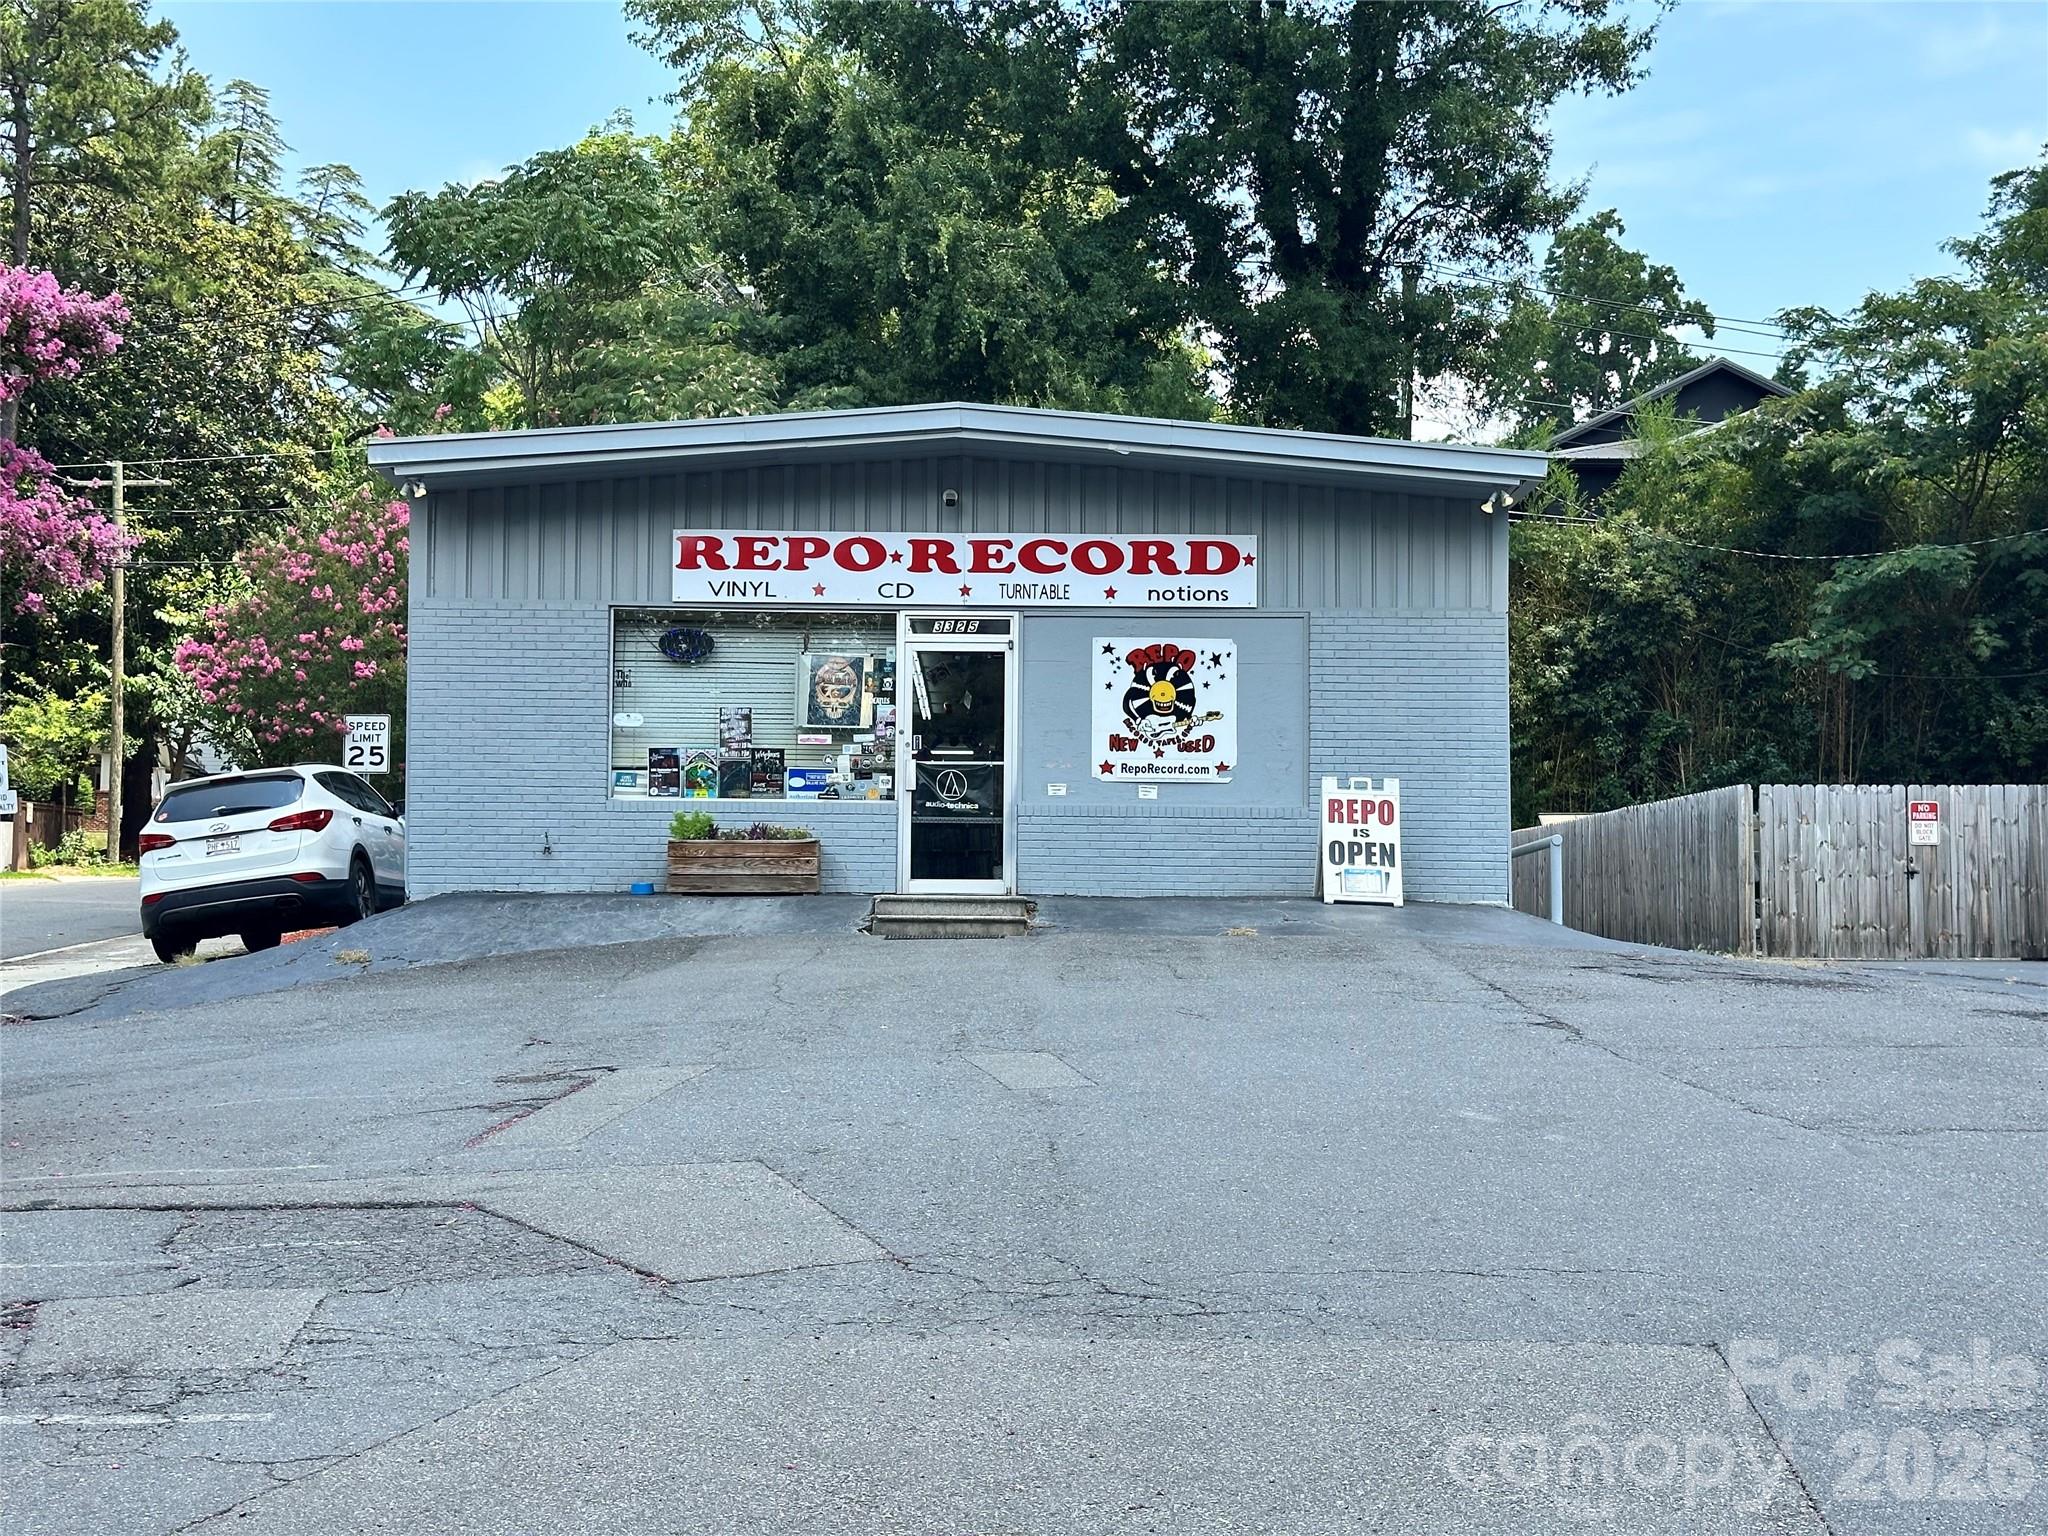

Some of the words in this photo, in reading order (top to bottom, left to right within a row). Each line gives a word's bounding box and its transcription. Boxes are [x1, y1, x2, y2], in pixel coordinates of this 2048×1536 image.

[675, 535, 887, 572] REPO
[907, 538, 1241, 576] RECORD
[708, 581, 777, 597] VINYL
[878, 583, 914, 598] CD
[999, 583, 1070, 600] TURNTABLE
[1147, 585, 1229, 602] notions
[933, 621, 979, 633] 3325
[1125, 643, 1197, 673] REPO
[348, 721, 386, 731] SPEED
[352, 733, 382, 743] LIMIT
[1109, 734, 1139, 752] NEW
[1177, 735, 1216, 752] USED
[348, 745, 385, 766] 25
[1120, 763, 1210, 776] RepoRecord.com
[925, 800, 979, 809] audio-technica
[1328, 798, 1395, 826] REPO
[1917, 804, 1930, 812] NO
[1353, 828, 1370, 838] IS
[1328, 840, 1396, 868] OPEN
